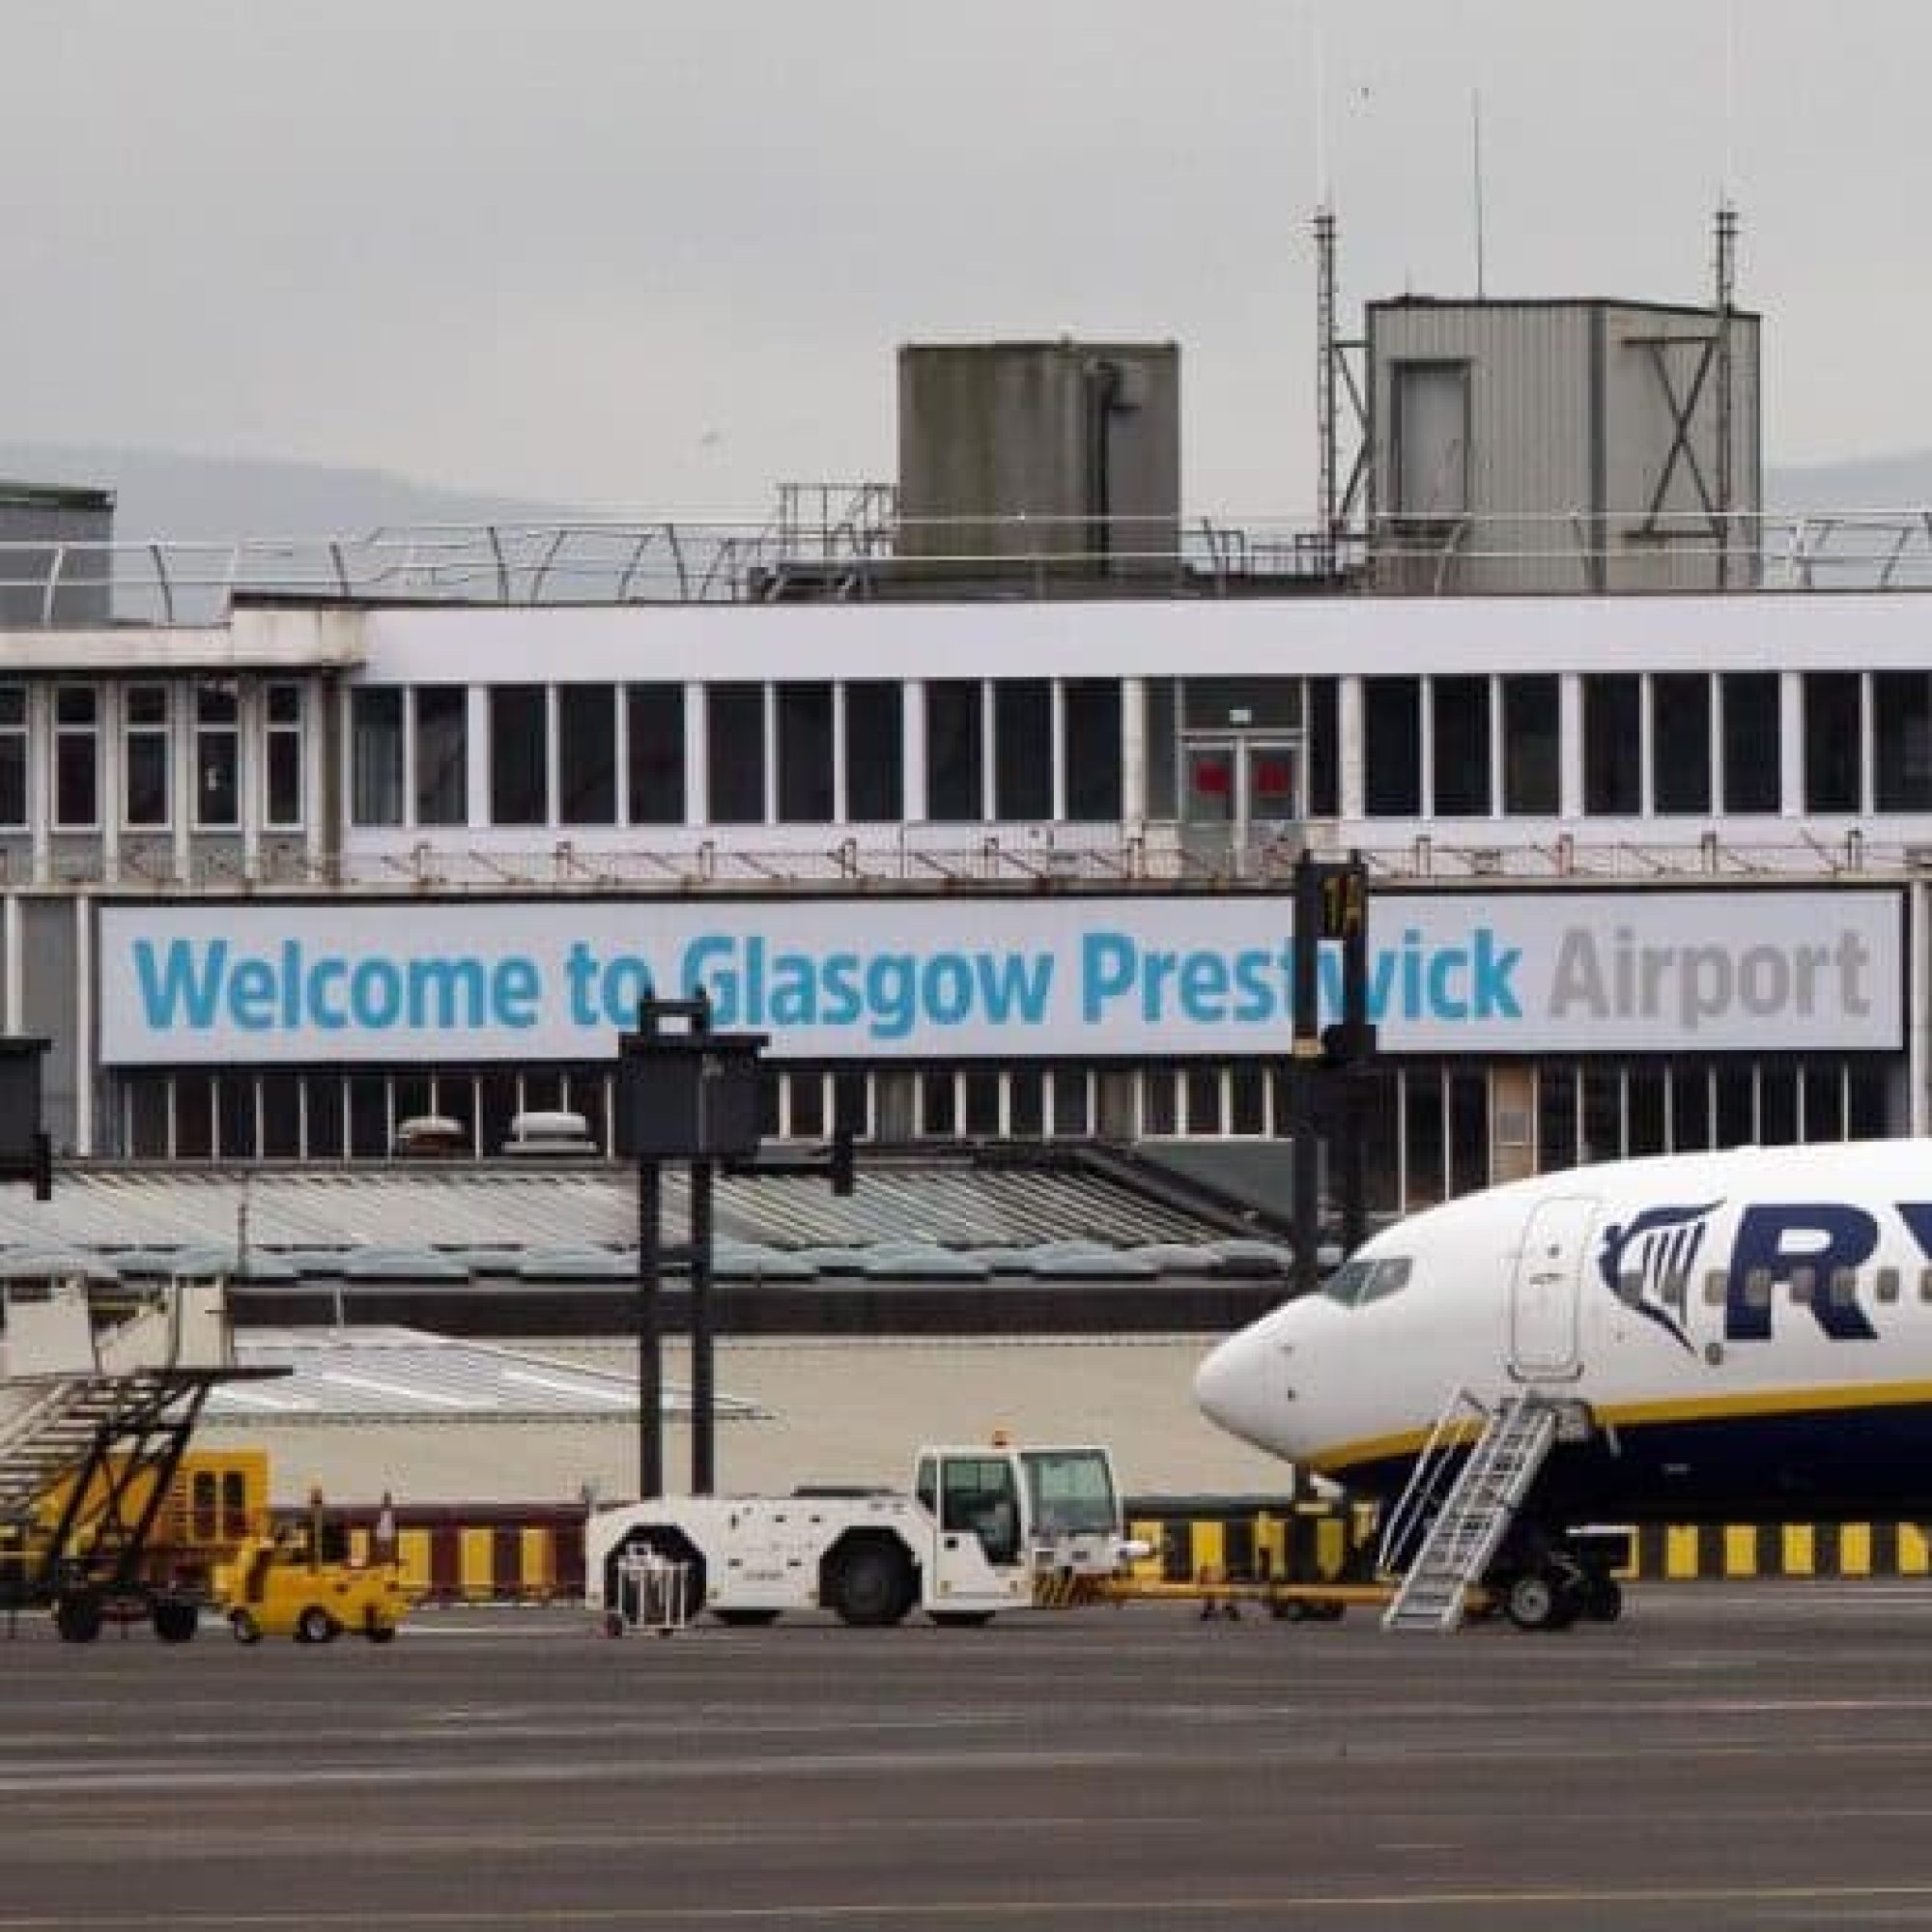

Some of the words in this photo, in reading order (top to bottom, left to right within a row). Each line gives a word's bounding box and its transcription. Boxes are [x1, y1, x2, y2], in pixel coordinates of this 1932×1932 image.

[131, 938, 540, 1030] Welcome
[566, 940, 648, 1028] to
[683, 935, 1054, 1039] Glasgow
[1549, 927, 1871, 1030] Airport
[1725, 1202, 1932, 1341] R
